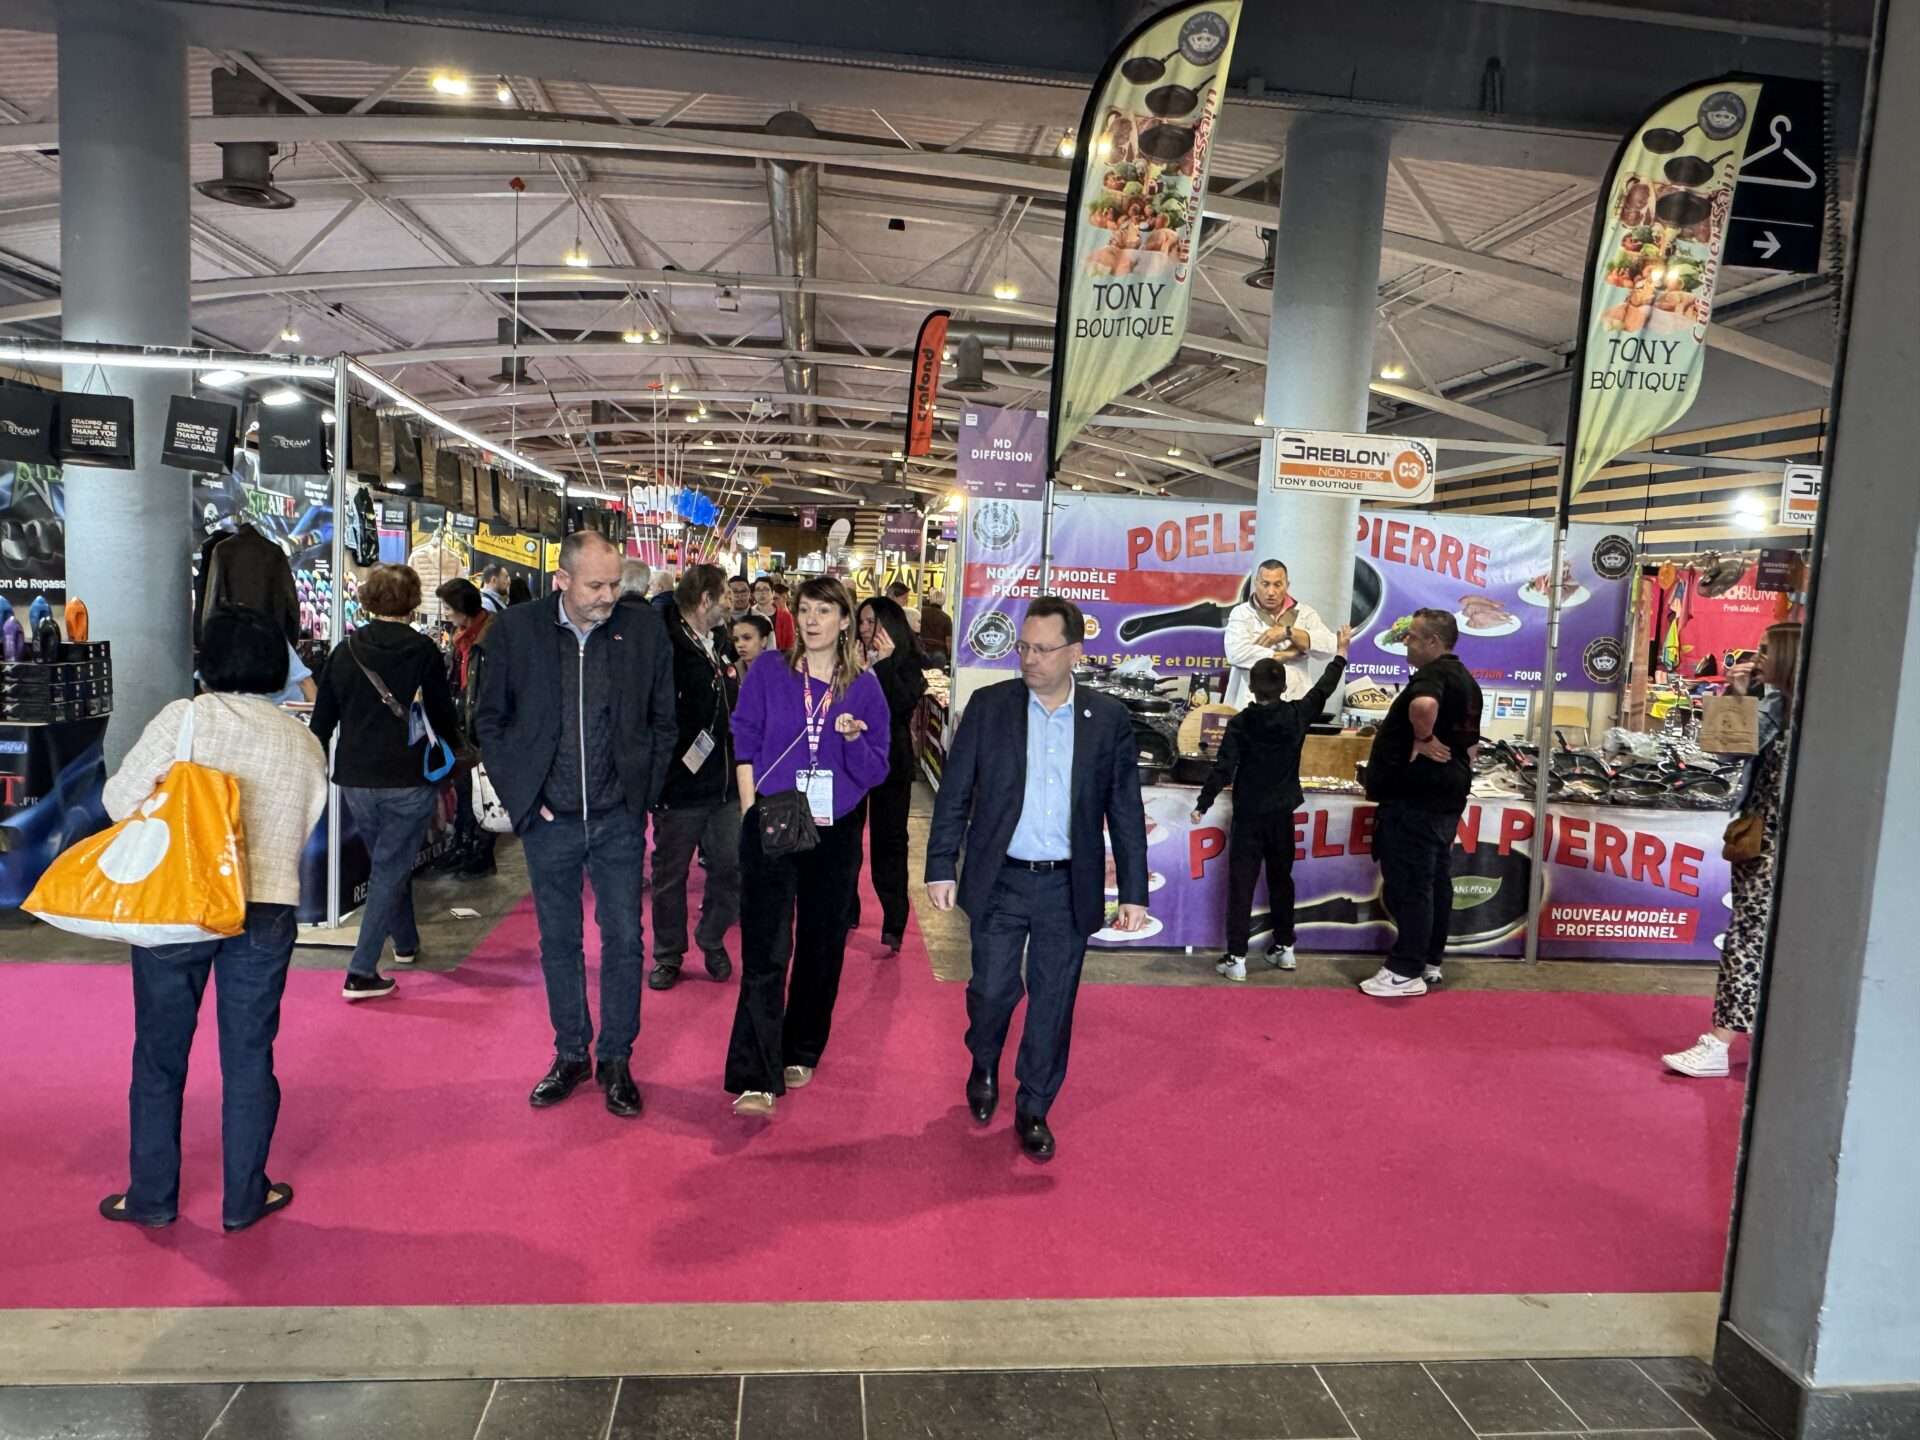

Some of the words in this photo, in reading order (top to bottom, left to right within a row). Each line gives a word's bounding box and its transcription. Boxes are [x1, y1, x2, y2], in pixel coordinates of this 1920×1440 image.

[1093, 283, 1166, 311] TONY
[1075, 316, 1175, 340] BOUTIQUE
[1608, 337, 1681, 365] TONY
[1590, 371, 1688, 393] BOUTIQUE
[72, 427, 98, 436] THANK
[100, 429, 117, 437] YOU
[175, 431, 200, 441] THANK
[201, 434, 218, 443] YOU
[993, 438, 1012, 449] MD
[971, 449, 1033, 463] DIFFUSION
[1281, 437, 1386, 466] GREBLON
[1318, 467, 1384, 481] NON-STICK
[1399, 462, 1421, 478] C3
[1279, 477, 1307, 487] TONY
[1309, 480, 1364, 491] BOUTIQUE
[803, 517, 814, 528] D
[1787, 512, 1815, 521] TONY
[1127, 510, 1256, 570] POELE
[14, 577, 28, 589] de
[1058, 568, 1117, 584] MODÈLE
[992, 585, 1110, 601] PROFESIONNEL
[1165, 656, 1181, 667] et
[1185, 656, 1231, 669] DIETE
[1344, 663, 1400, 675] LECTRIQUE
[1514, 670, 1542, 681] FOUR
[1189, 805, 1379, 880] PELE
[1453, 805, 1482, 854] N
[1499, 806, 1705, 897] PIERRE
[1551, 907, 1623, 921] NOUVEAU
[1626, 908, 1687, 924] MODÈLE
[1556, 924, 1679, 939] PROFESSIONNEL
